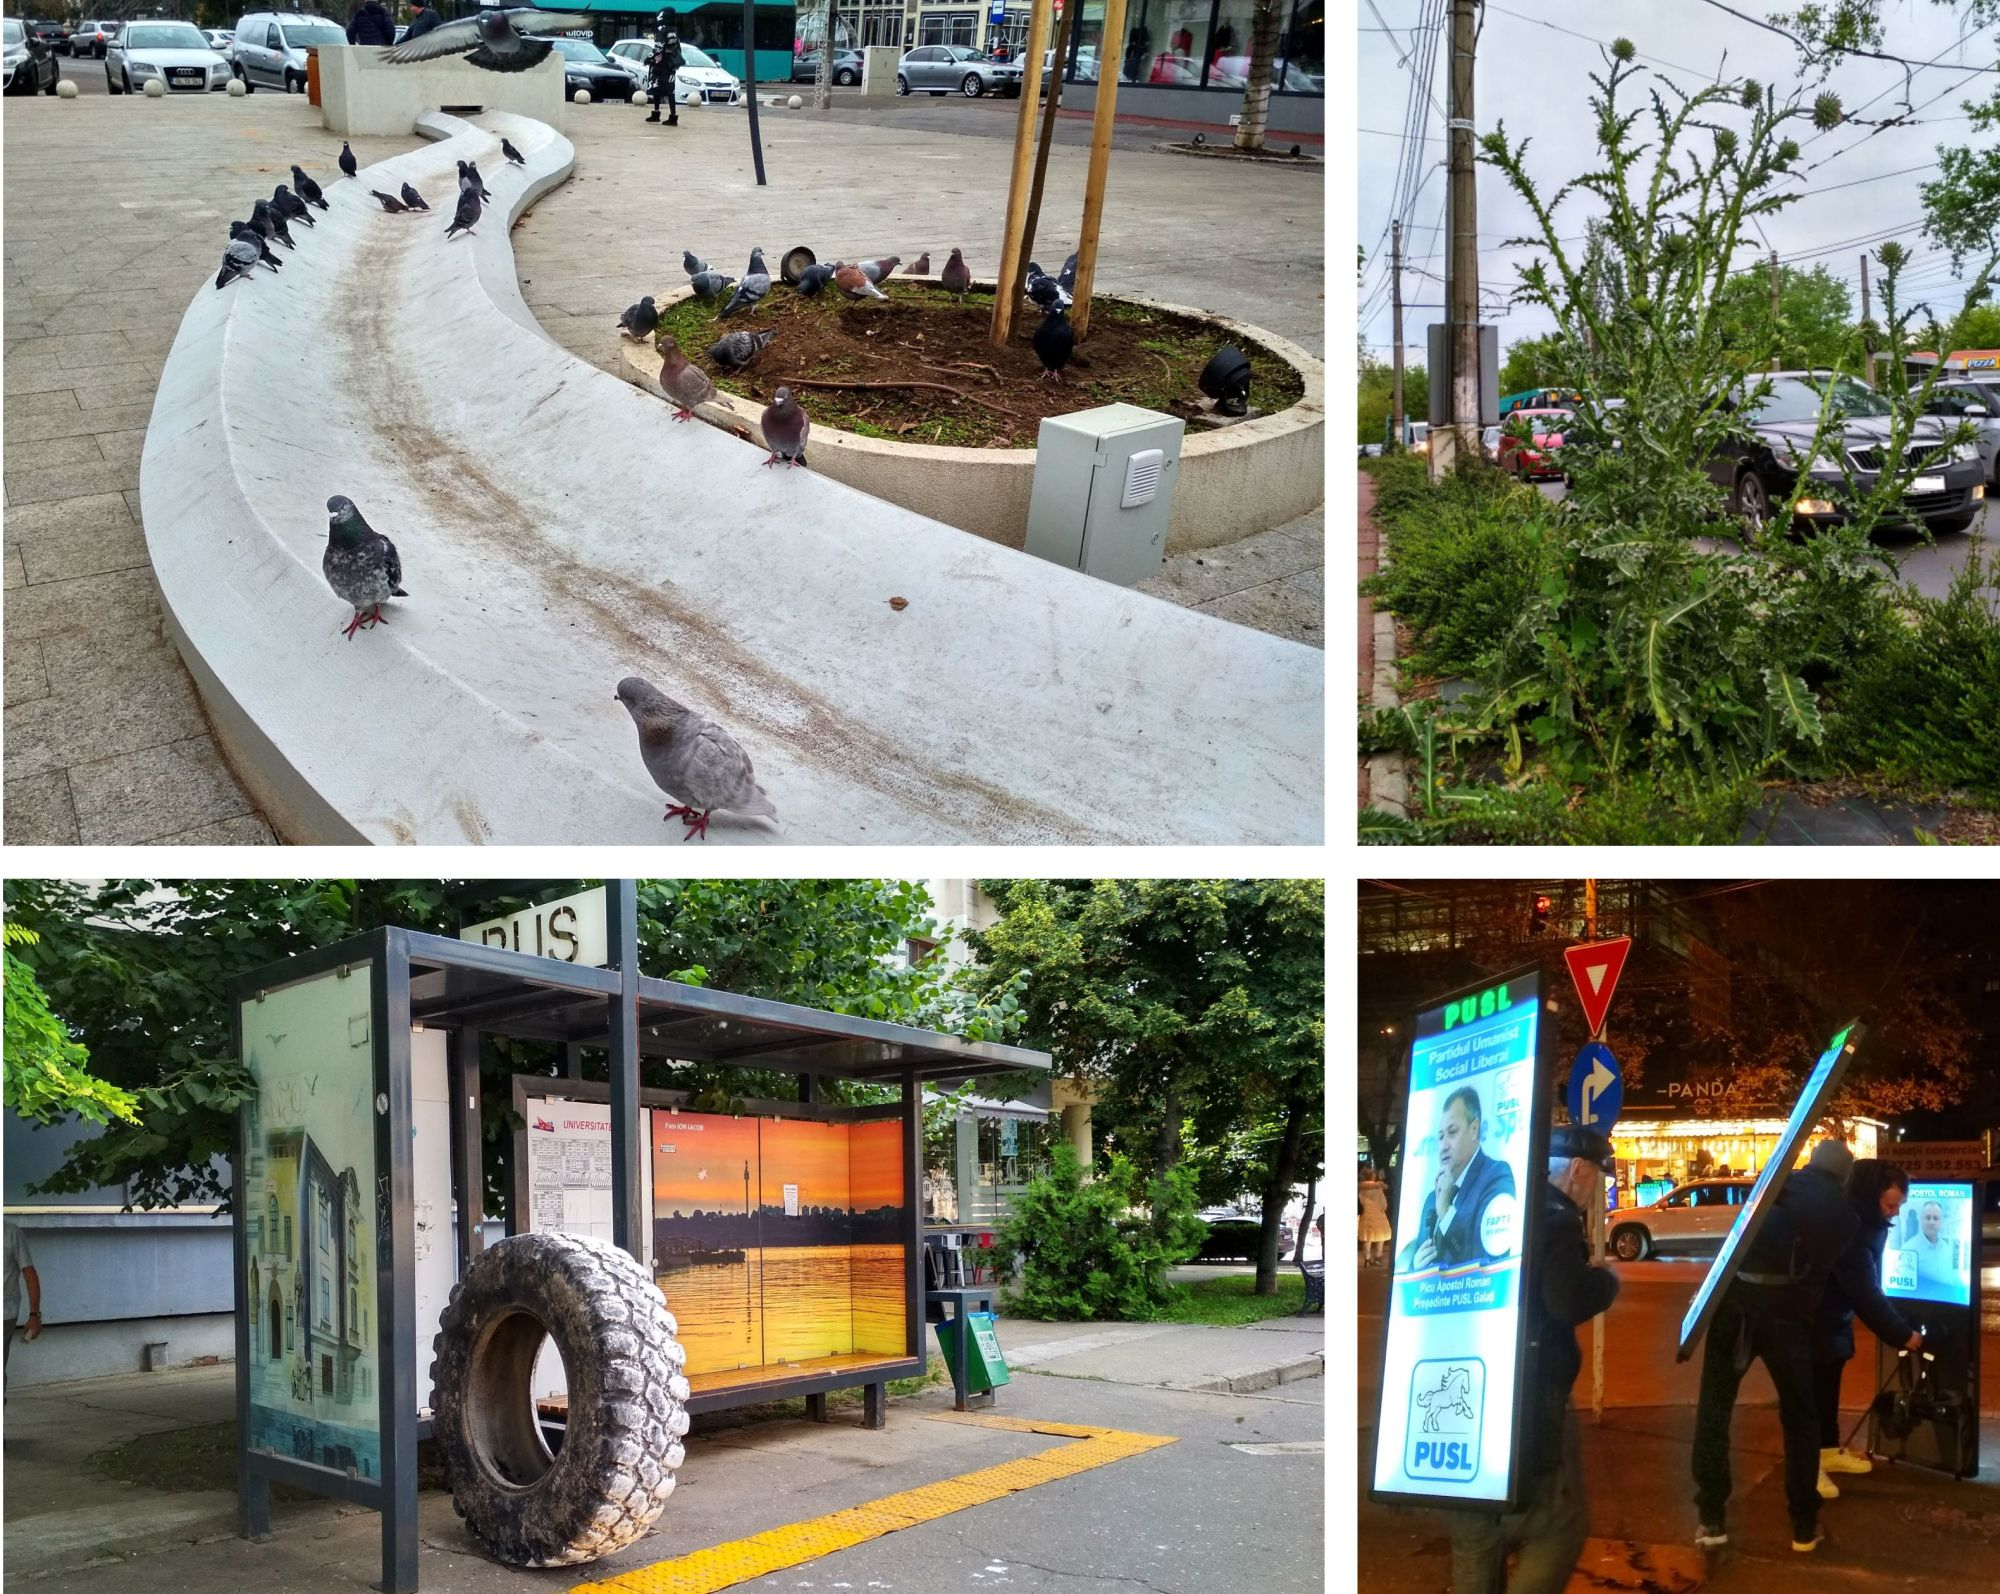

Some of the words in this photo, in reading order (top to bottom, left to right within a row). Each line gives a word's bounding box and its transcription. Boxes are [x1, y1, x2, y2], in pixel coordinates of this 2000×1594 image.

[1444, 984, 1512, 1031] PUSL
[1428, 1041, 1471, 1065] Partidul
[1472, 1026, 1519, 1052] Umanist
[1435, 1059, 1469, 1082] Social
[1471, 1047, 1509, 1072] Liberal
[1668, 1082, 1737, 1098] PANDA
[1909, 1189, 1937, 1198] POSTOL
[1436, 1277, 1464, 1294] Apostol
[1465, 1276, 1491, 1288] Roman
[1889, 1276, 1915, 1287] PUSL
[1452, 1293, 1472, 1306] PUSL
[1414, 1441, 1472, 1471] PUSL
